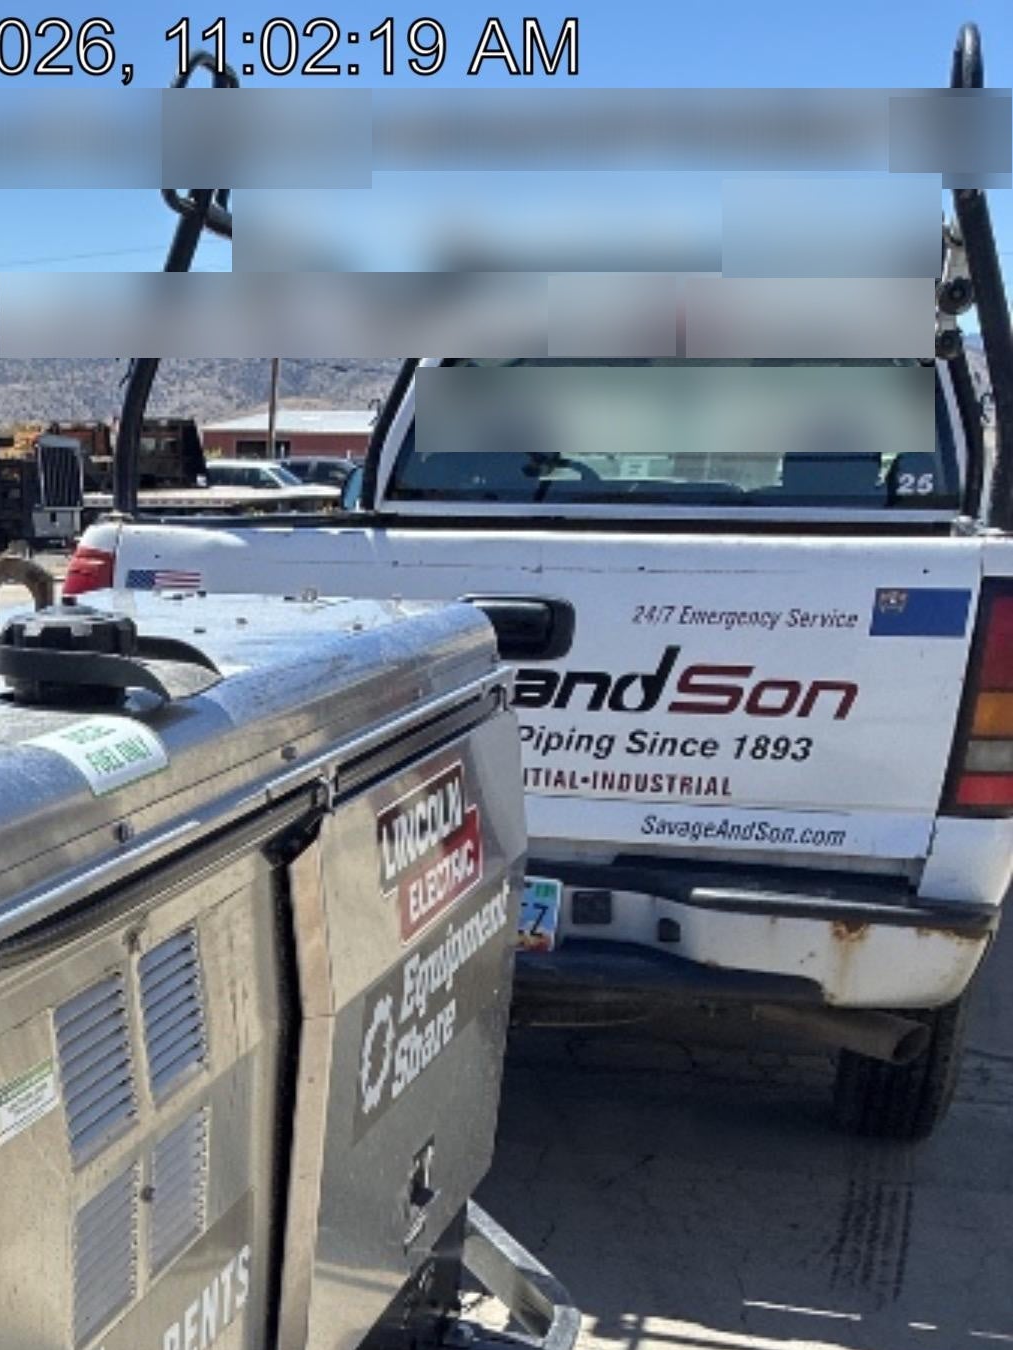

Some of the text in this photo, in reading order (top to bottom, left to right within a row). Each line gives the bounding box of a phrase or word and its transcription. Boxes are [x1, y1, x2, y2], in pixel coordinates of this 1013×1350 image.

[631, 605, 858, 631] 24/7 Emergency Service
[519, 724, 814, 762] Piping Since 1893
[382, 777, 464, 880] LINCOLN
[641, 814, 847, 847] SavageAndSon.com
[409, 838, 475, 924] ELECTRIC
[399, 877, 511, 1026] Equipment
[392, 998, 456, 1100] Share
